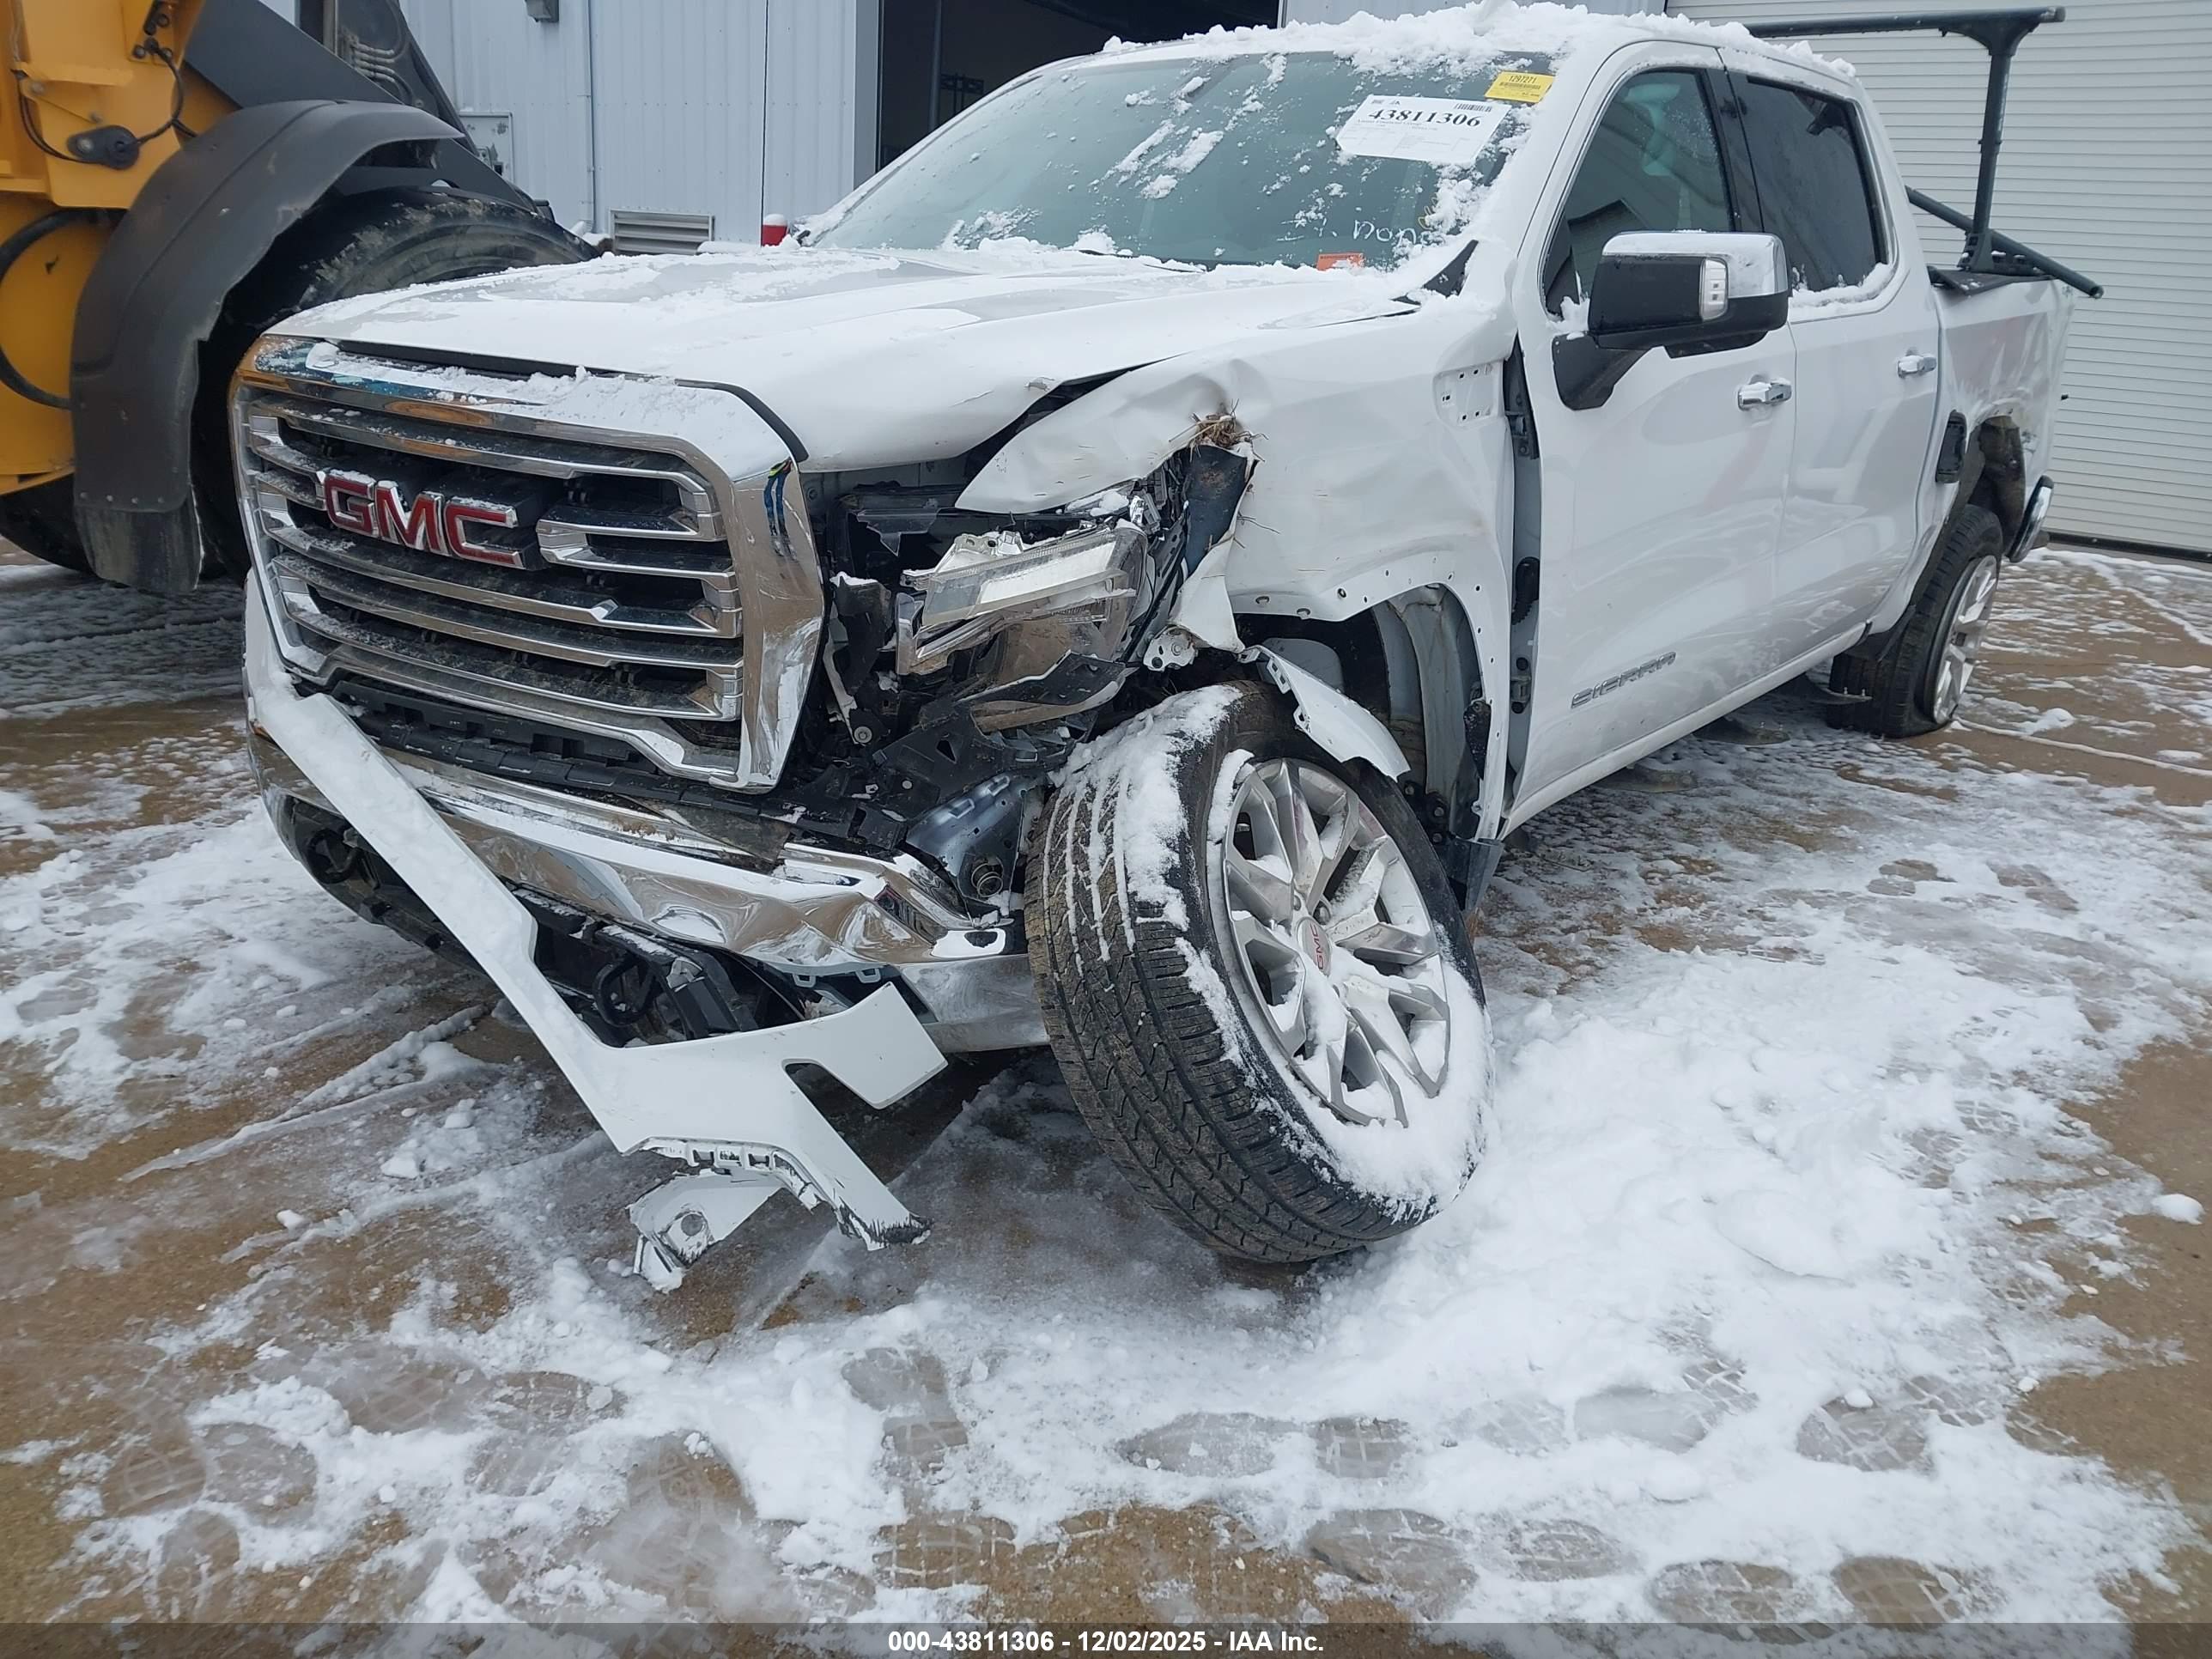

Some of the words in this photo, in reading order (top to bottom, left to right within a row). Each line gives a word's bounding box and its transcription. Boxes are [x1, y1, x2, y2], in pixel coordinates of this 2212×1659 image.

[1368, 108, 1484, 127] 43811306
[324, 469, 527, 570] GMC
[1571, 651, 1677, 709] SIERRA
[1309, 921, 1324, 970] GMC
